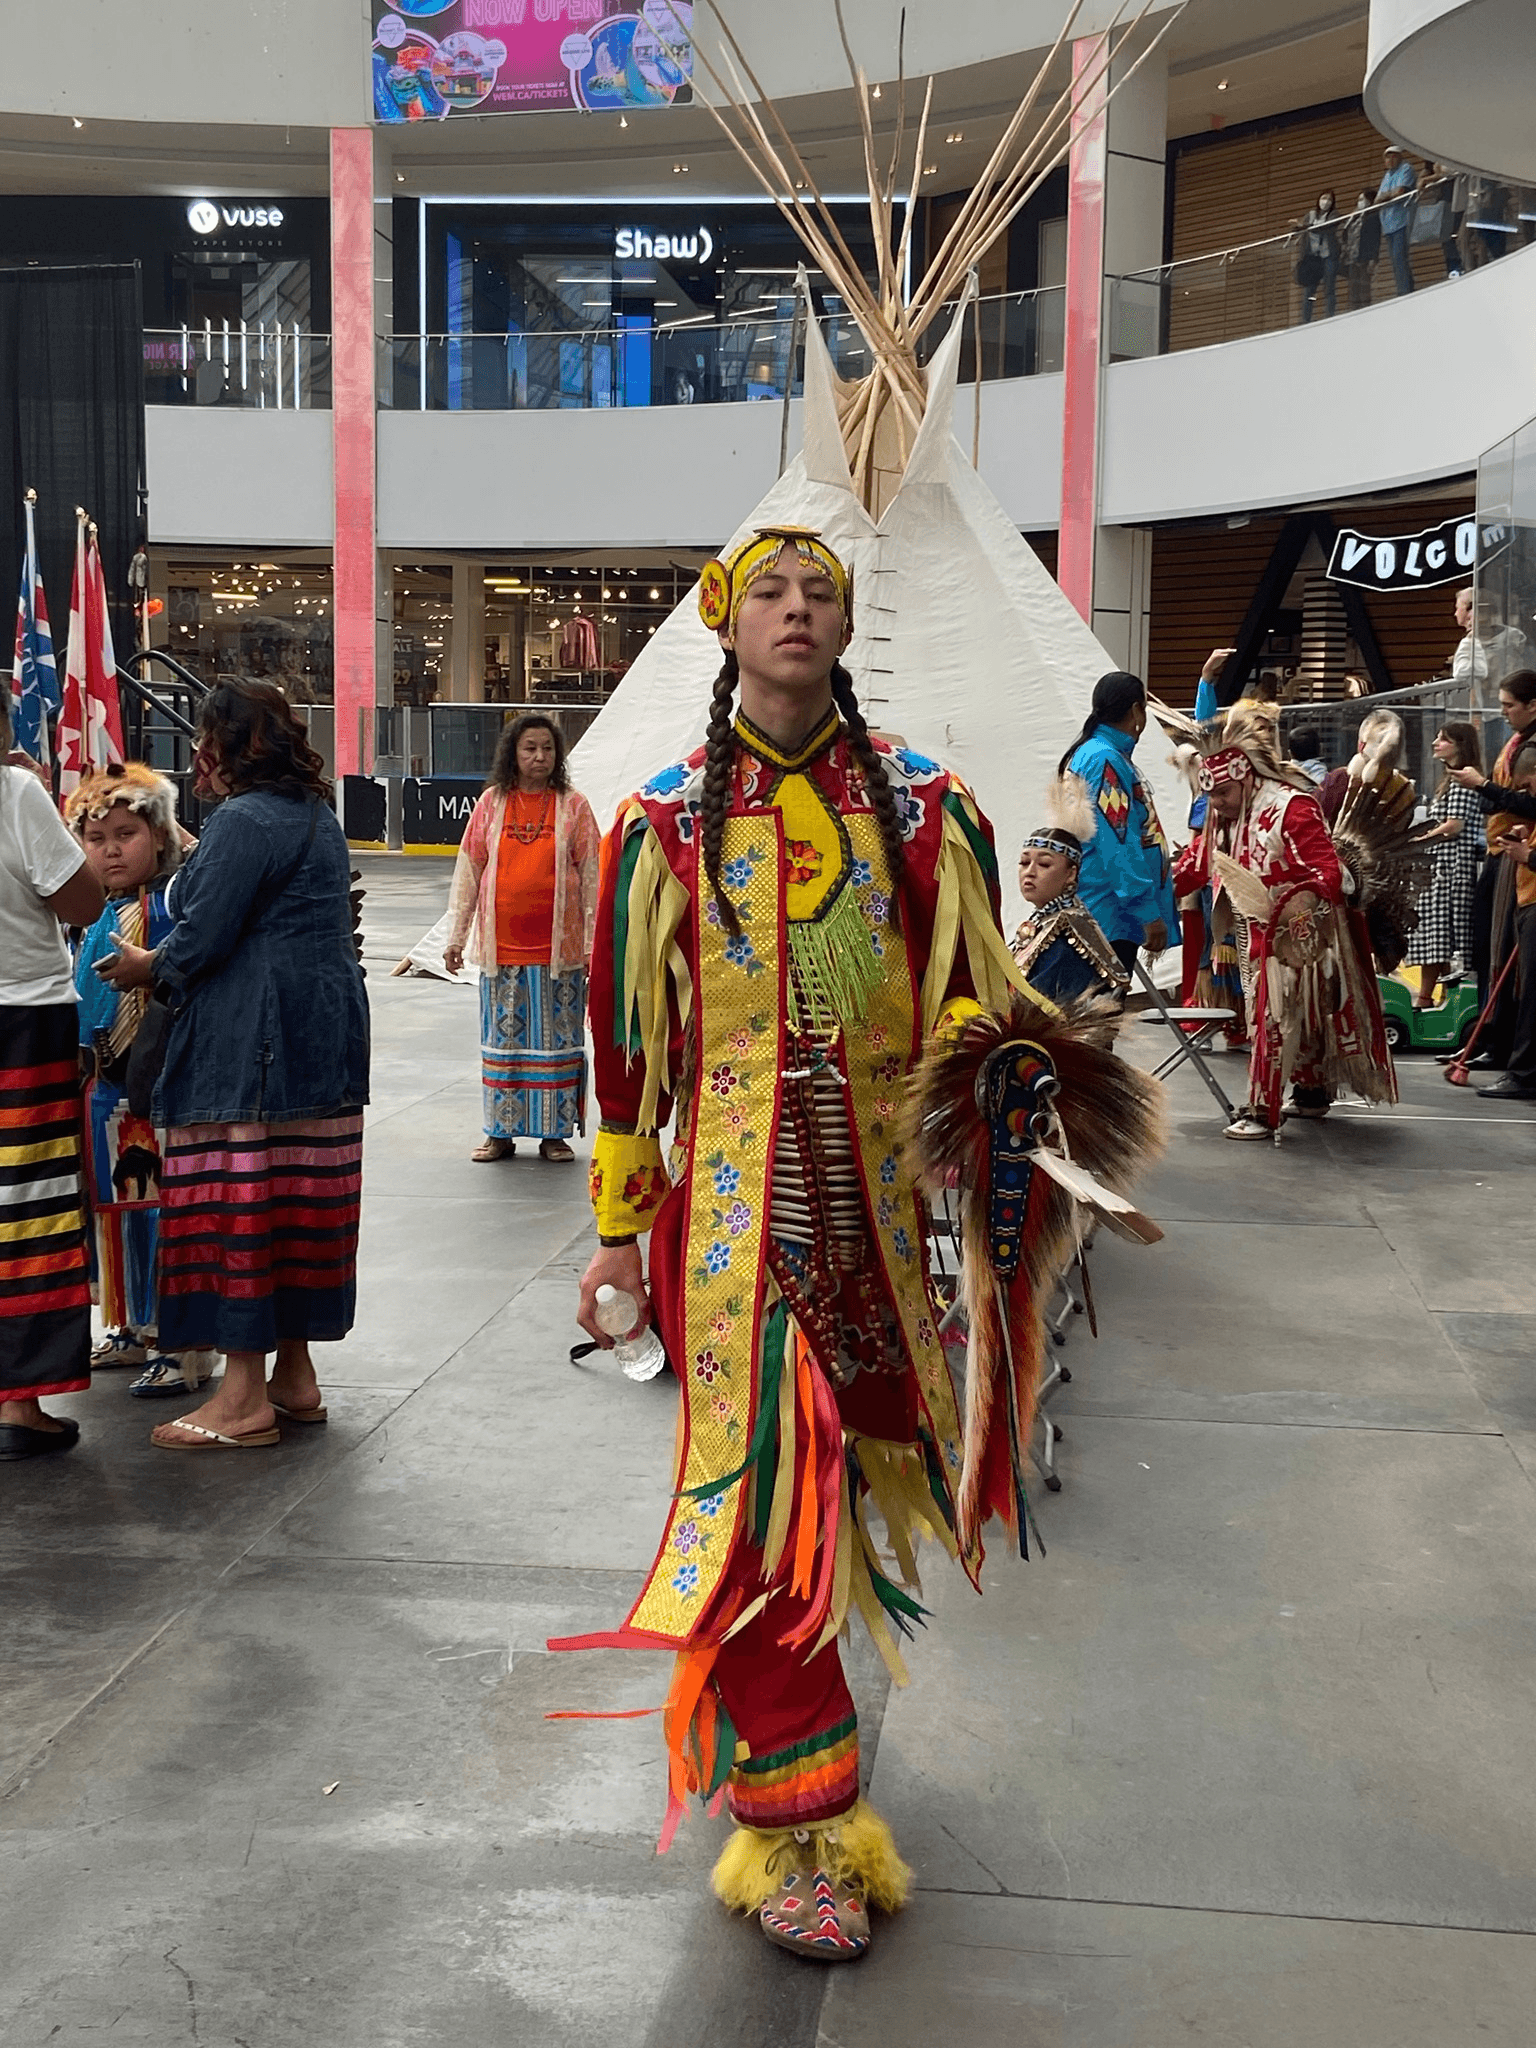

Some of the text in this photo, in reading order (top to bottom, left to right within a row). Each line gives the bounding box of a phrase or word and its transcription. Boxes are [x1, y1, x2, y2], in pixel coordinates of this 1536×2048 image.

[463, 0, 602, 27] NOW OPEN
[222, 209, 283, 227] vuse
[615, 229, 698, 259] Shaw
[1341, 522, 1505, 579] VOLCOM
[394, 643, 413, 653] ALE
